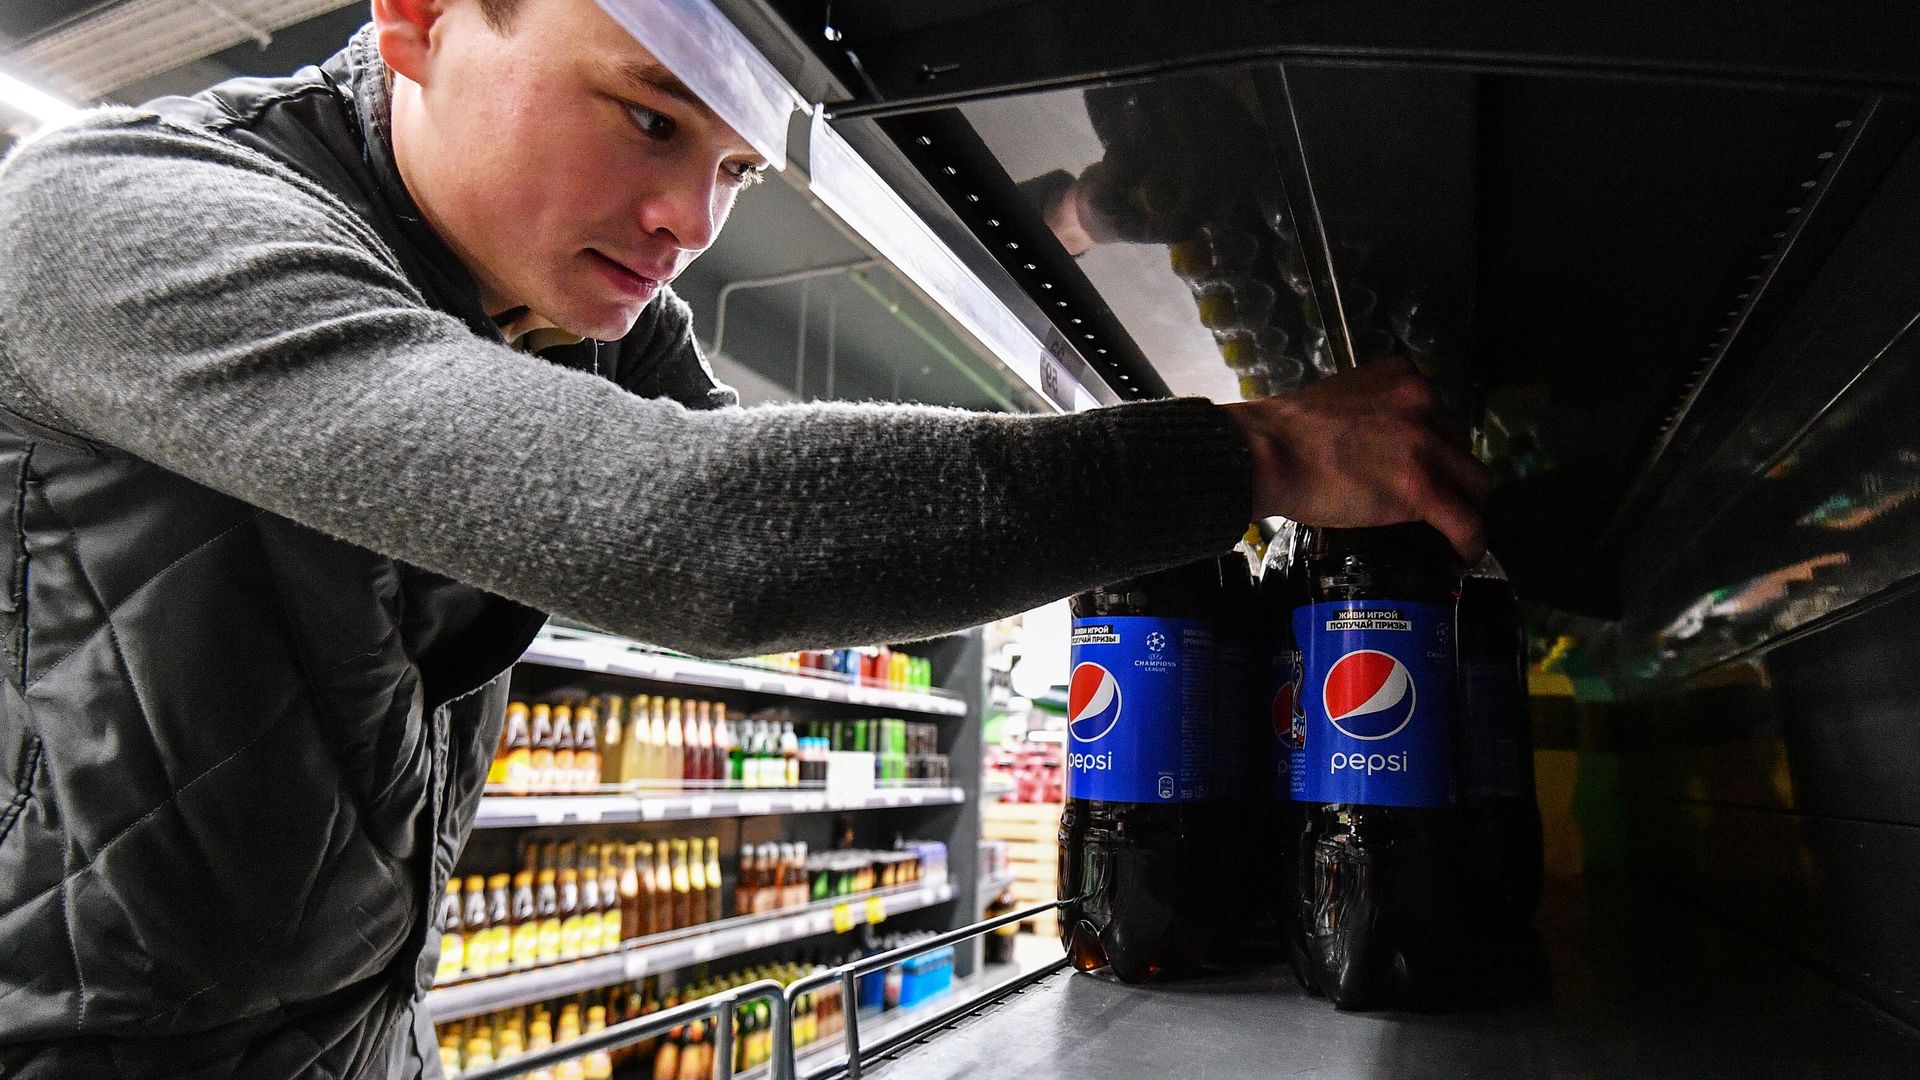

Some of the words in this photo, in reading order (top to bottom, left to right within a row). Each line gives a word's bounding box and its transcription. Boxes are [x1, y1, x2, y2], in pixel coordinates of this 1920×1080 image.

[1338, 611, 1365, 619] ЖИВИ
[1366, 610, 1398, 619] ИГРОЙ
[1330, 619, 1373, 630] ПОЛУЧАЙ
[1374, 620, 1408, 630] ПРИЗЫ
[1087, 625, 1109, 634] ИГРОЙ
[1091, 635, 1116, 643] ПРИЗЫ
[1134, 660, 1177, 668] CHAMPIONS
[1068, 751, 1112, 774] pepsi
[1331, 751, 1408, 775] pepsi
